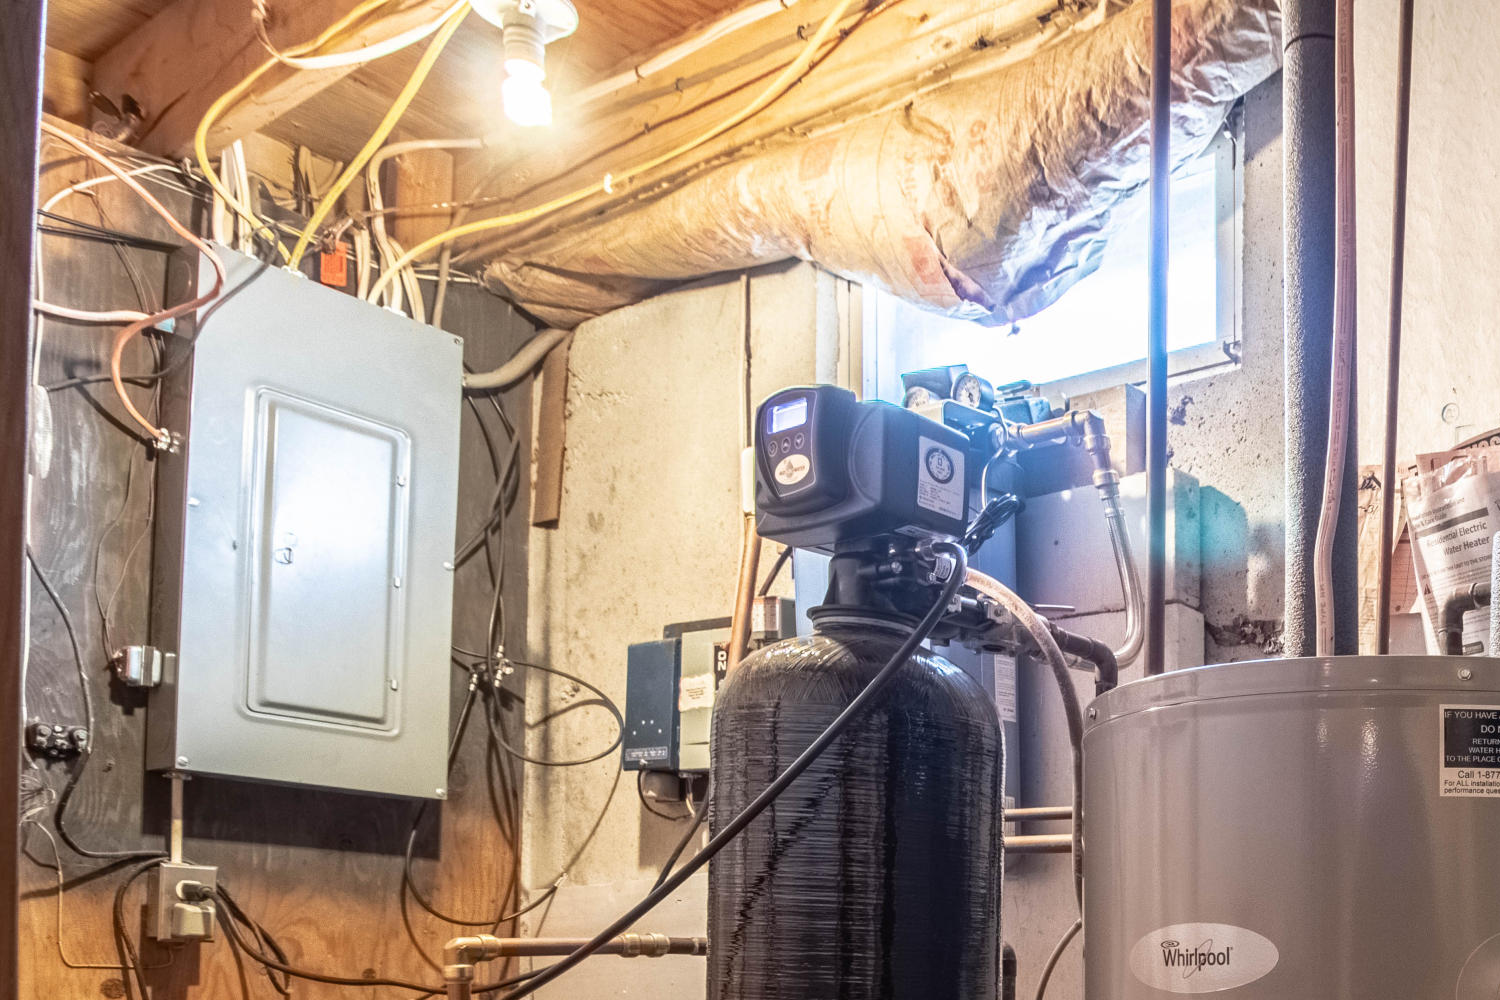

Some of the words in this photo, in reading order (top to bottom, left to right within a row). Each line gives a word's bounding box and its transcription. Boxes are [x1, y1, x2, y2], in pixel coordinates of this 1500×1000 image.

[1459, 521, 1488, 537] Electric
[1443, 543, 1462, 557] Water
[1463, 536, 1490, 551] Heater
[717, 651, 727, 671] ON
[1444, 711, 1453, 719] IF
[1455, 711, 1473, 719] YOU
[1475, 712, 1498, 720] HAVE
[1480, 725, 1496, 734] DO
[1457, 770, 1475, 779] Call
[1444, 787, 1485, 795] performance
[1162, 946, 1231, 972] Whirlpool
